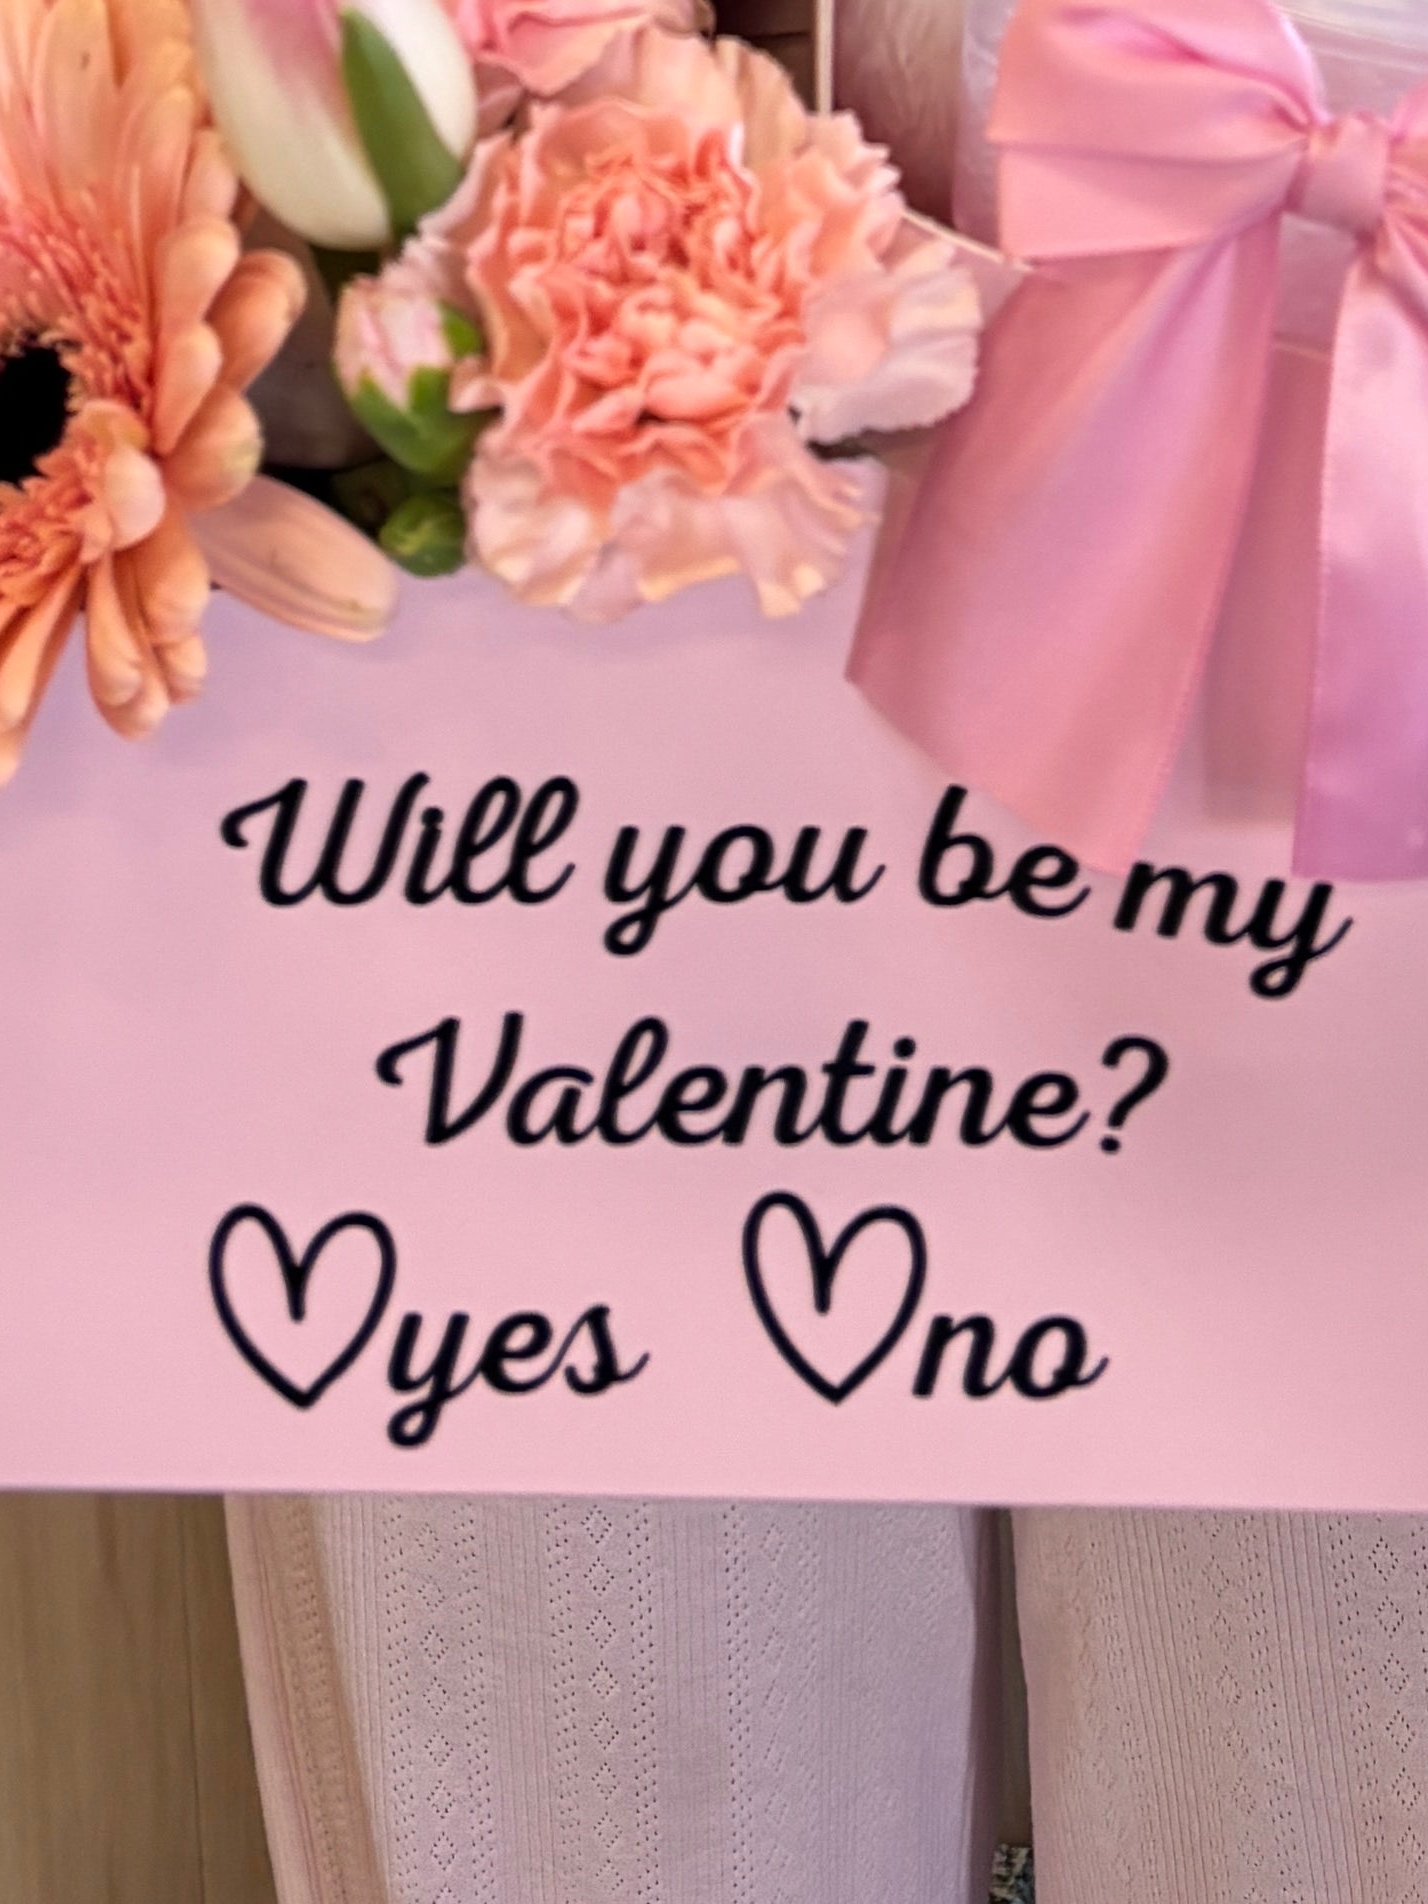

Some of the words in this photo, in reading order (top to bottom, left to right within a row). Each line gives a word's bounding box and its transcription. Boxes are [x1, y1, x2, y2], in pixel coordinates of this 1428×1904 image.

[219, 771, 580, 908] Will
[603, 824, 887, 957] you
[917, 784, 1092, 919] be
[1112, 860, 1354, 1000] my
[374, 1010, 1171, 1155] Valentine?
[386, 1303, 650, 1448] yes
[912, 1313, 1110, 1400] no
